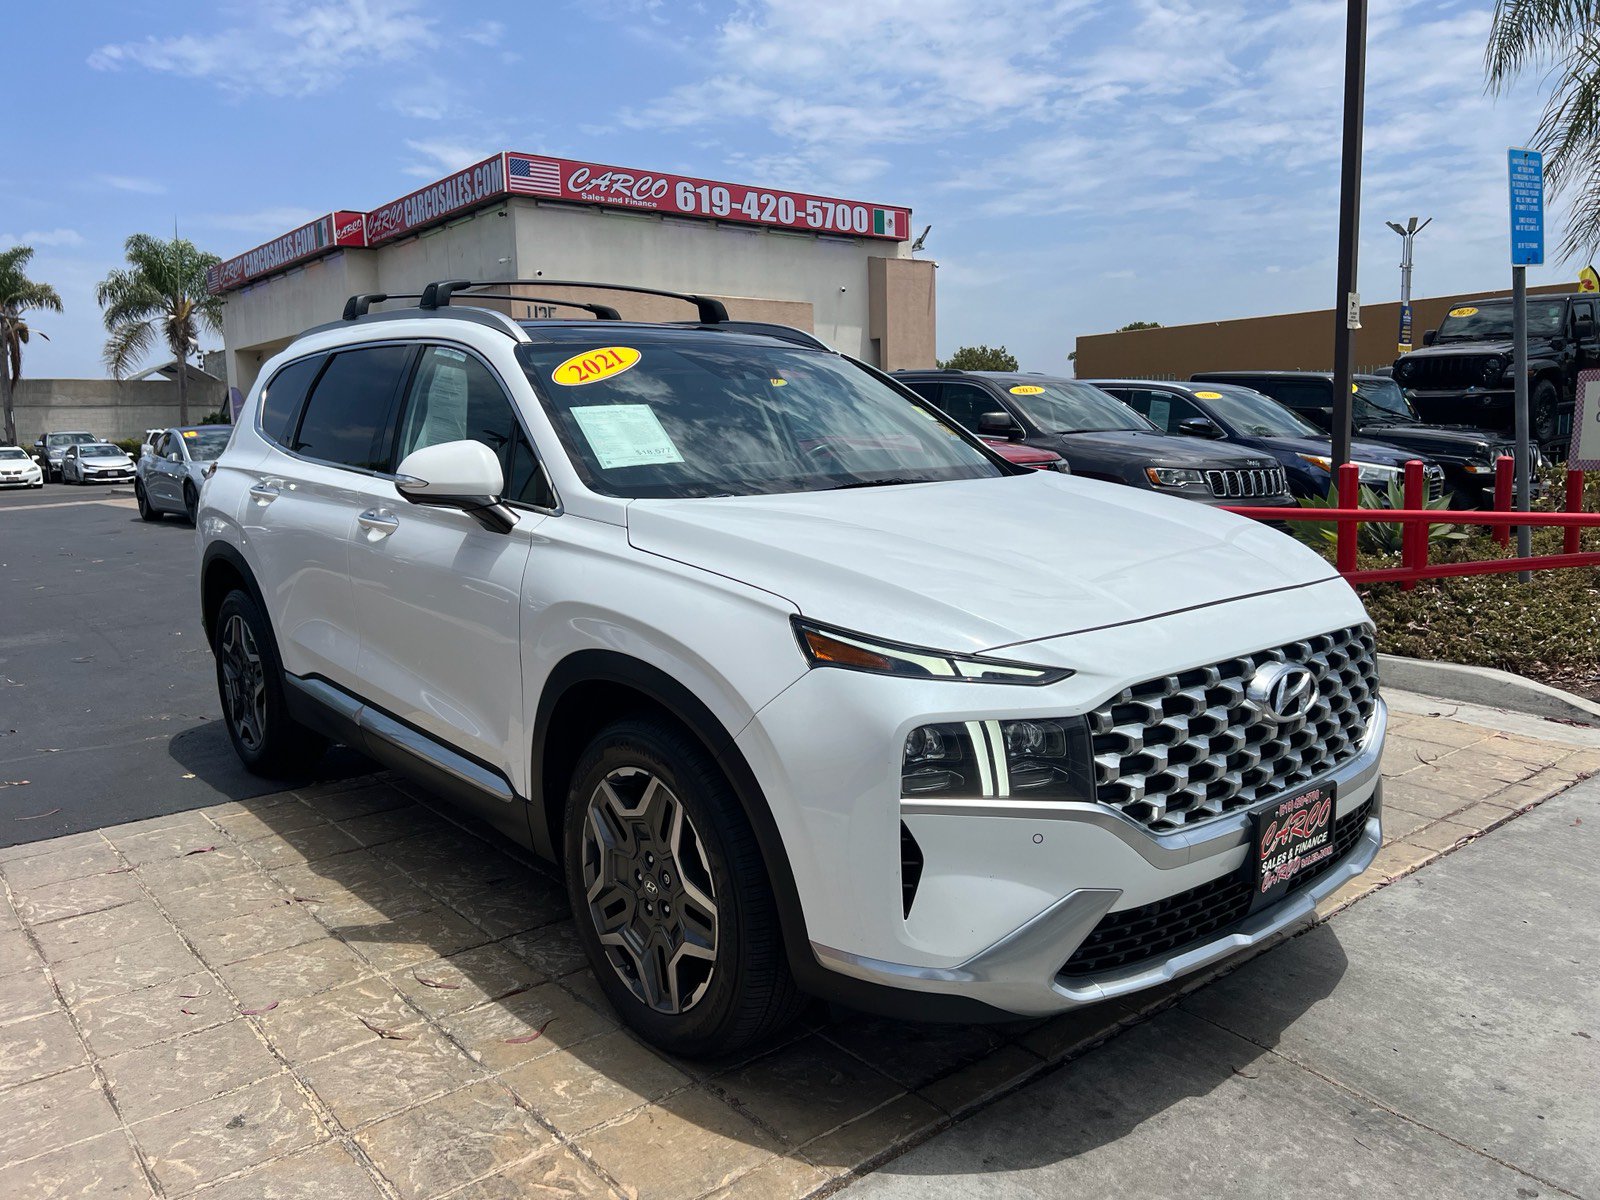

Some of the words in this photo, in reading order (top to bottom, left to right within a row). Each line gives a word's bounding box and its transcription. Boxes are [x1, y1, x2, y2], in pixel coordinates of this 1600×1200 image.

[367, 202, 403, 239] CARCO
[404, 159, 503, 228] CARCOSALES.COM
[567, 167, 669, 200] CARCO
[675, 181, 868, 233] 619-420-5700
[581, 192, 605, 202] Sales
[625, 198, 658, 208] Finance
[243, 225, 317, 278] CARCOSALES.COM
[337, 219, 362, 240] CARCO
[569, 349, 627, 381] 2021
[1260, 797, 1331, 860] CARCO
[1261, 851, 1287, 874] SALES
[1288, 847, 1294, 859] &
[1294, 831, 1329, 856] FINANCE
